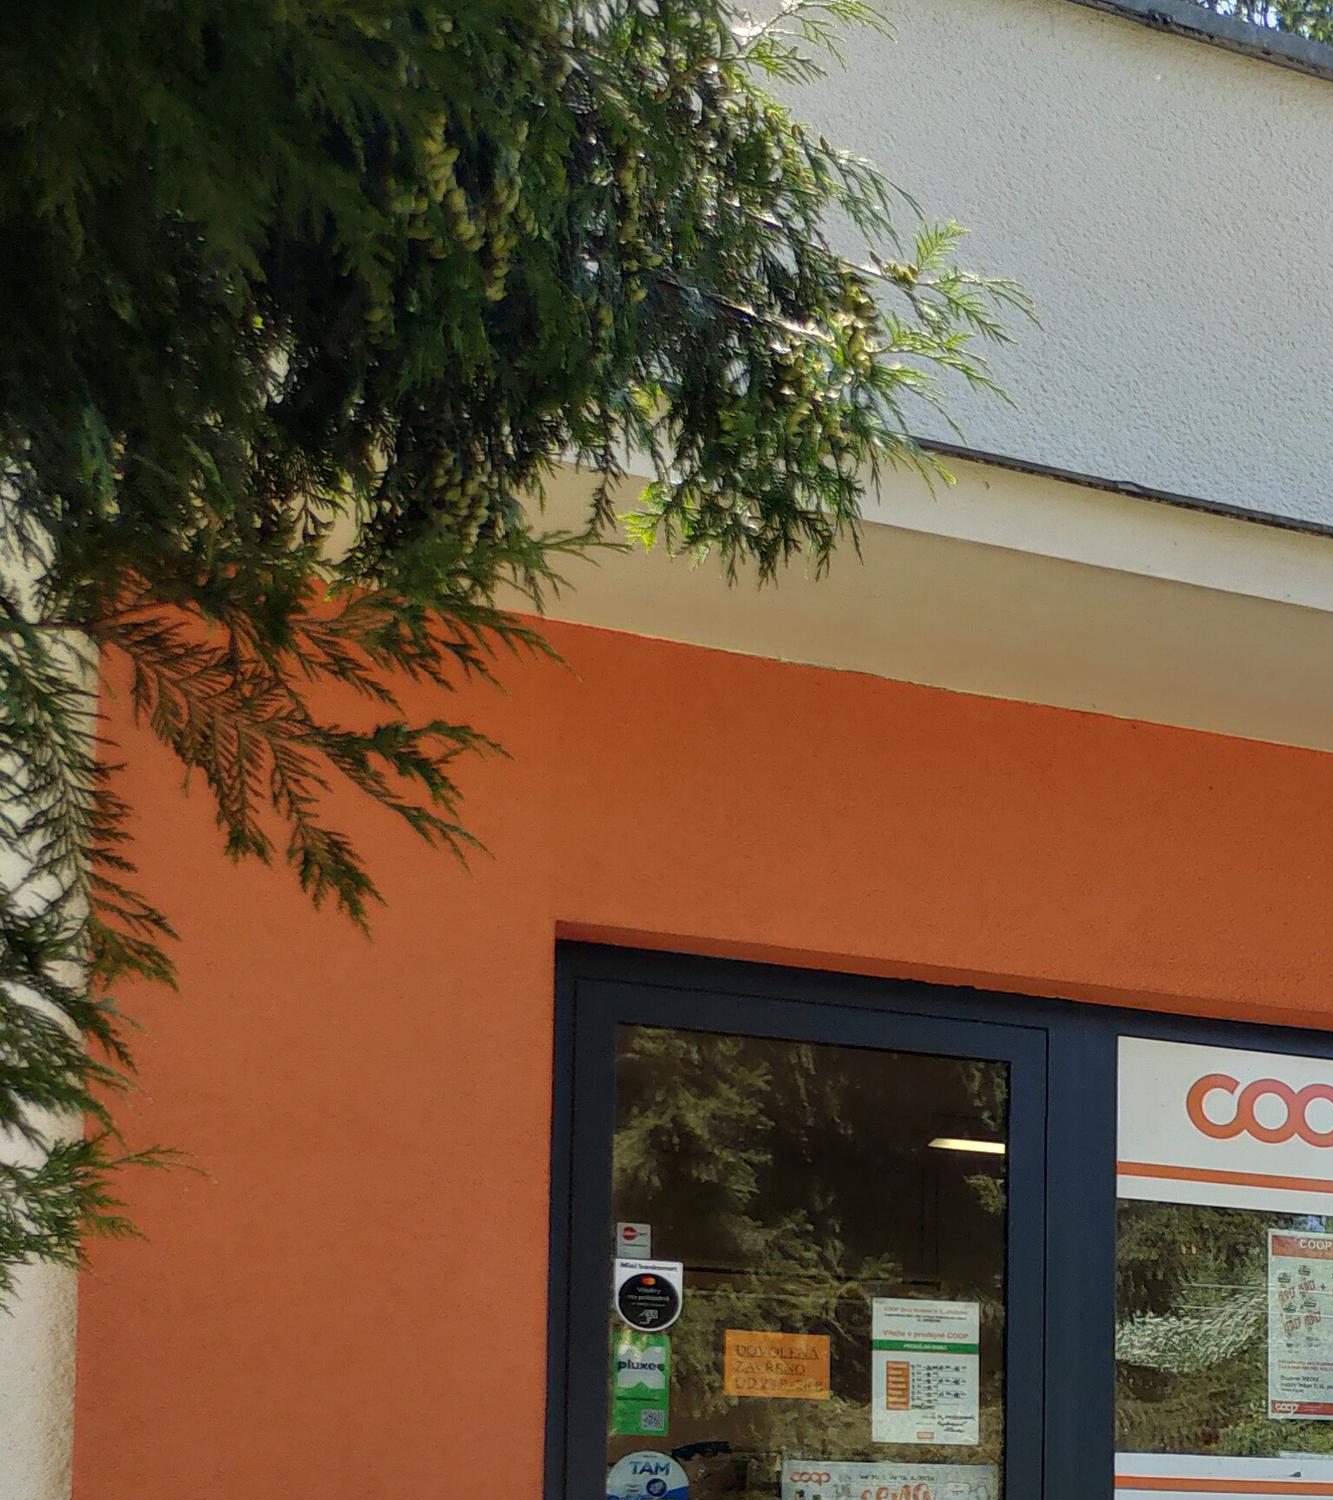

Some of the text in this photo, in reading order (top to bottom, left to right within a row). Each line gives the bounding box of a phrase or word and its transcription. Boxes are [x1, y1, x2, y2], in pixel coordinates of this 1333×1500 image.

[1300, 1240, 1332, 1251] COOP
[617, 1359, 666, 1373] pluxee
[629, 1461, 672, 1476] TAM
